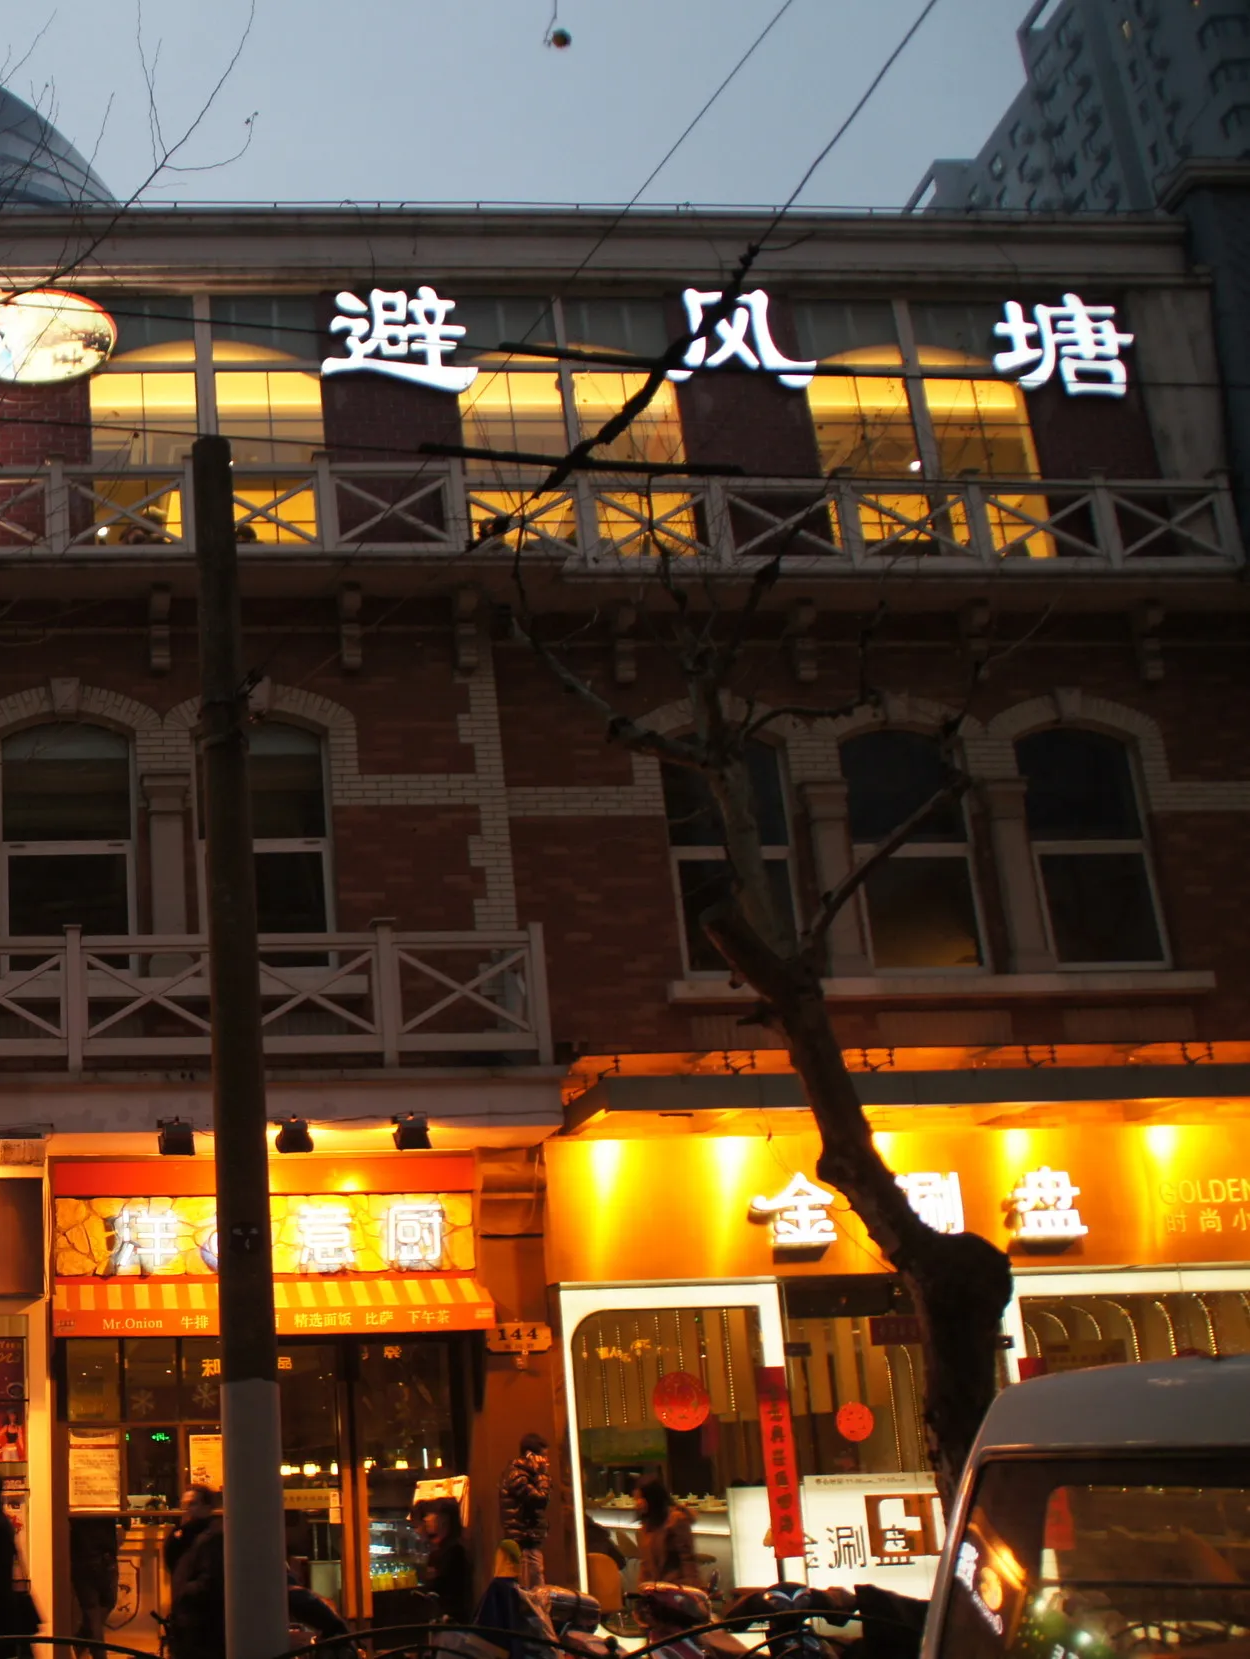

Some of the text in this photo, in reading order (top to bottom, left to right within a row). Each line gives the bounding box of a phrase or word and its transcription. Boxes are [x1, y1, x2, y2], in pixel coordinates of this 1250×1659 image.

[322, 285, 1135, 397] 避风塘
[751, 1166, 1088, 1243] 金涮盘
[102, 1317, 163, 1330] Mr.Onion
[180, 1314, 210, 1329] 牛排
[294, 1312, 352, 1328] 精选面饭
[365, 1310, 394, 1326] 比萨
[407, 1309, 451, 1325] 下午茶
[497, 1328, 538, 1340] 144
